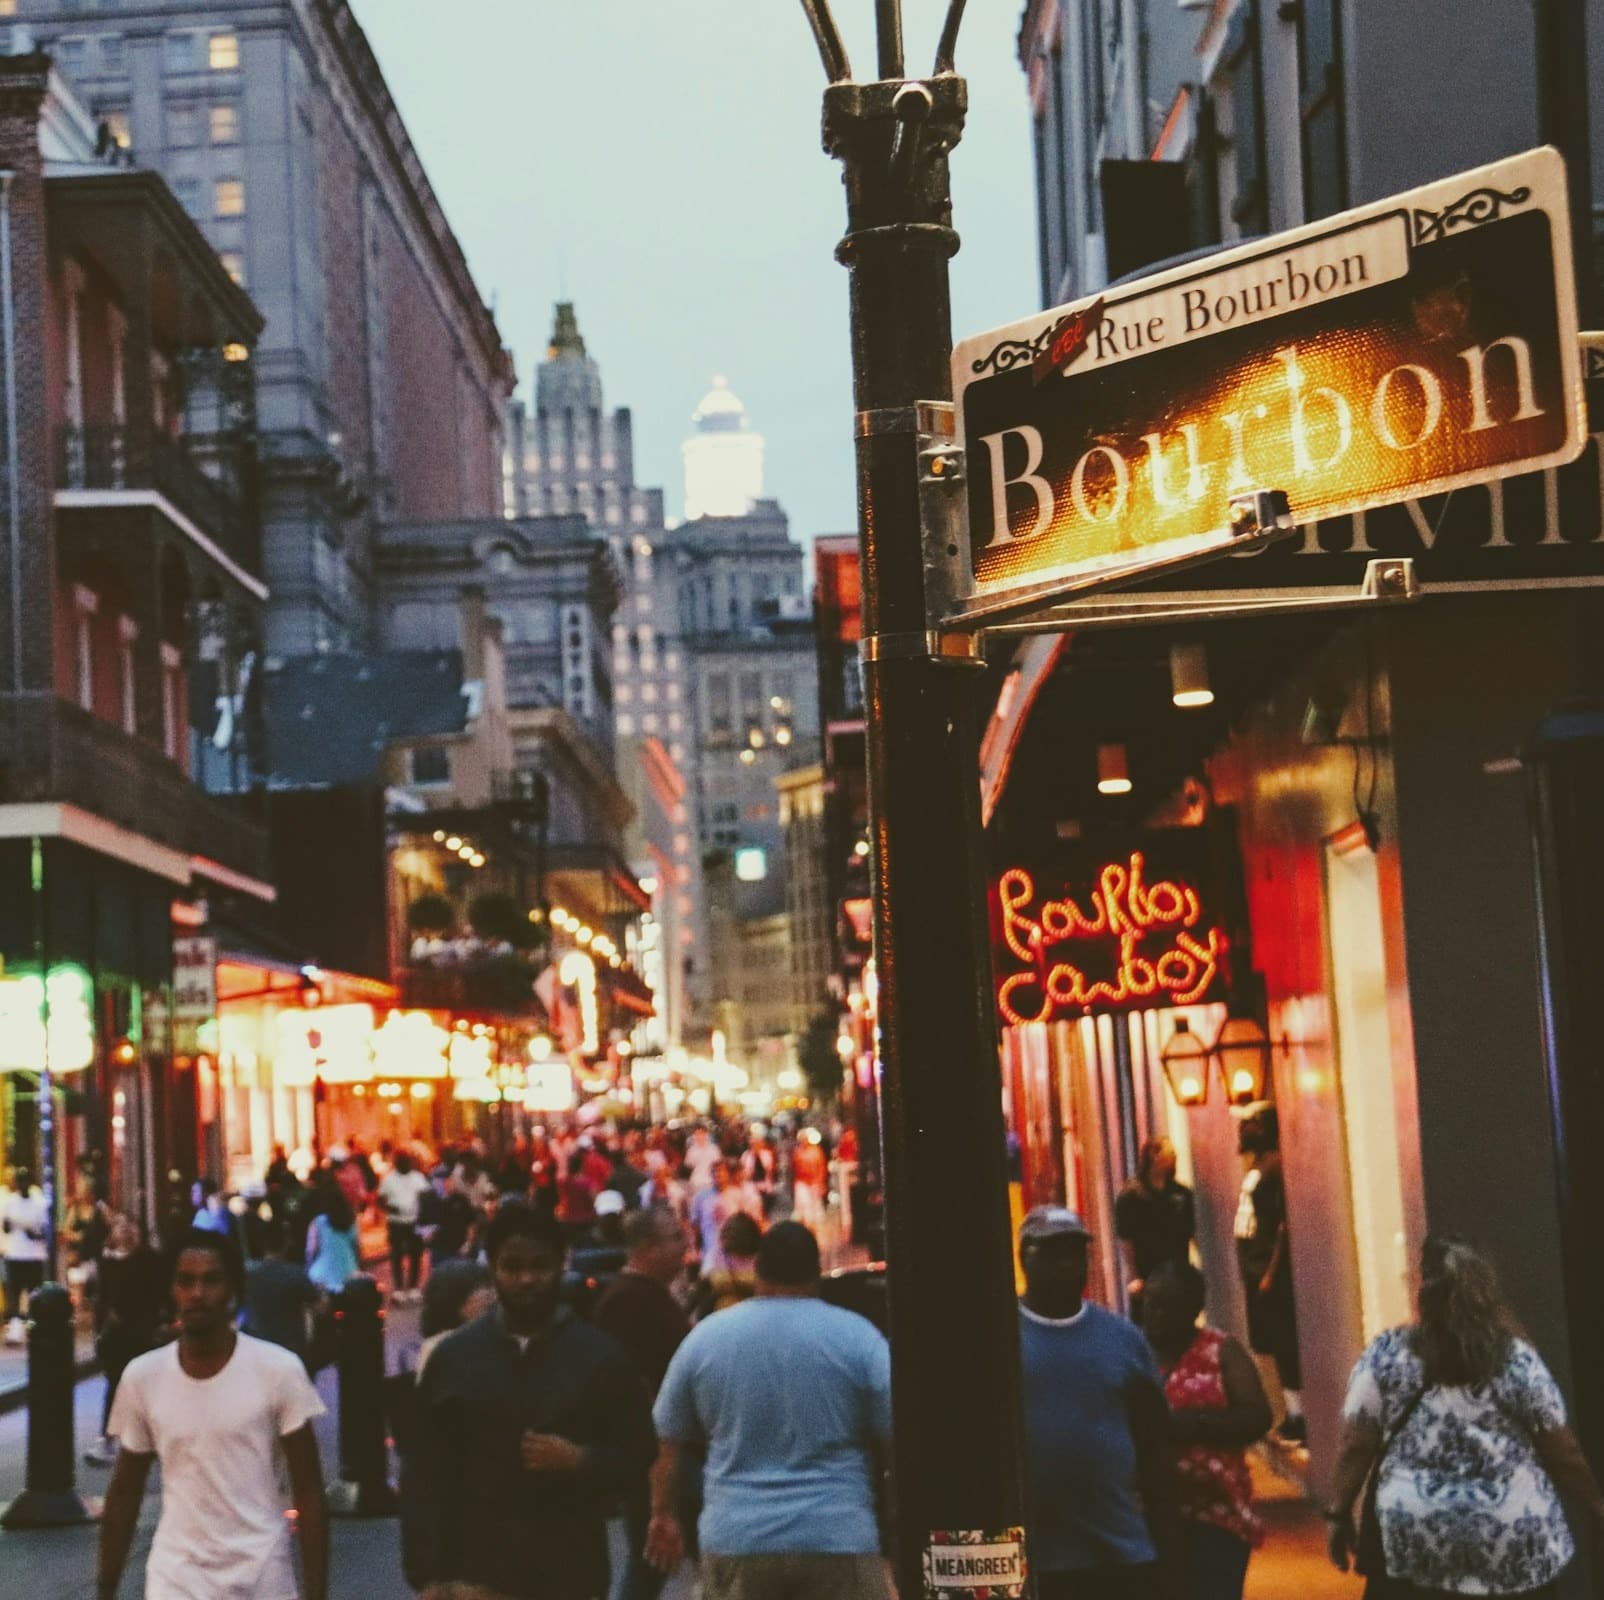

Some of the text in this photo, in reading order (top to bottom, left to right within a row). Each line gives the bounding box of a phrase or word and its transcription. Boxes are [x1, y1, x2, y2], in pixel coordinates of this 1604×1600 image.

[1095, 316, 1165, 360] Rue
[1181, 252, 1369, 334] Bourbon
[978, 336, 1547, 549] Bourbon
[935, 1556, 1017, 1577] MEANGREEN
